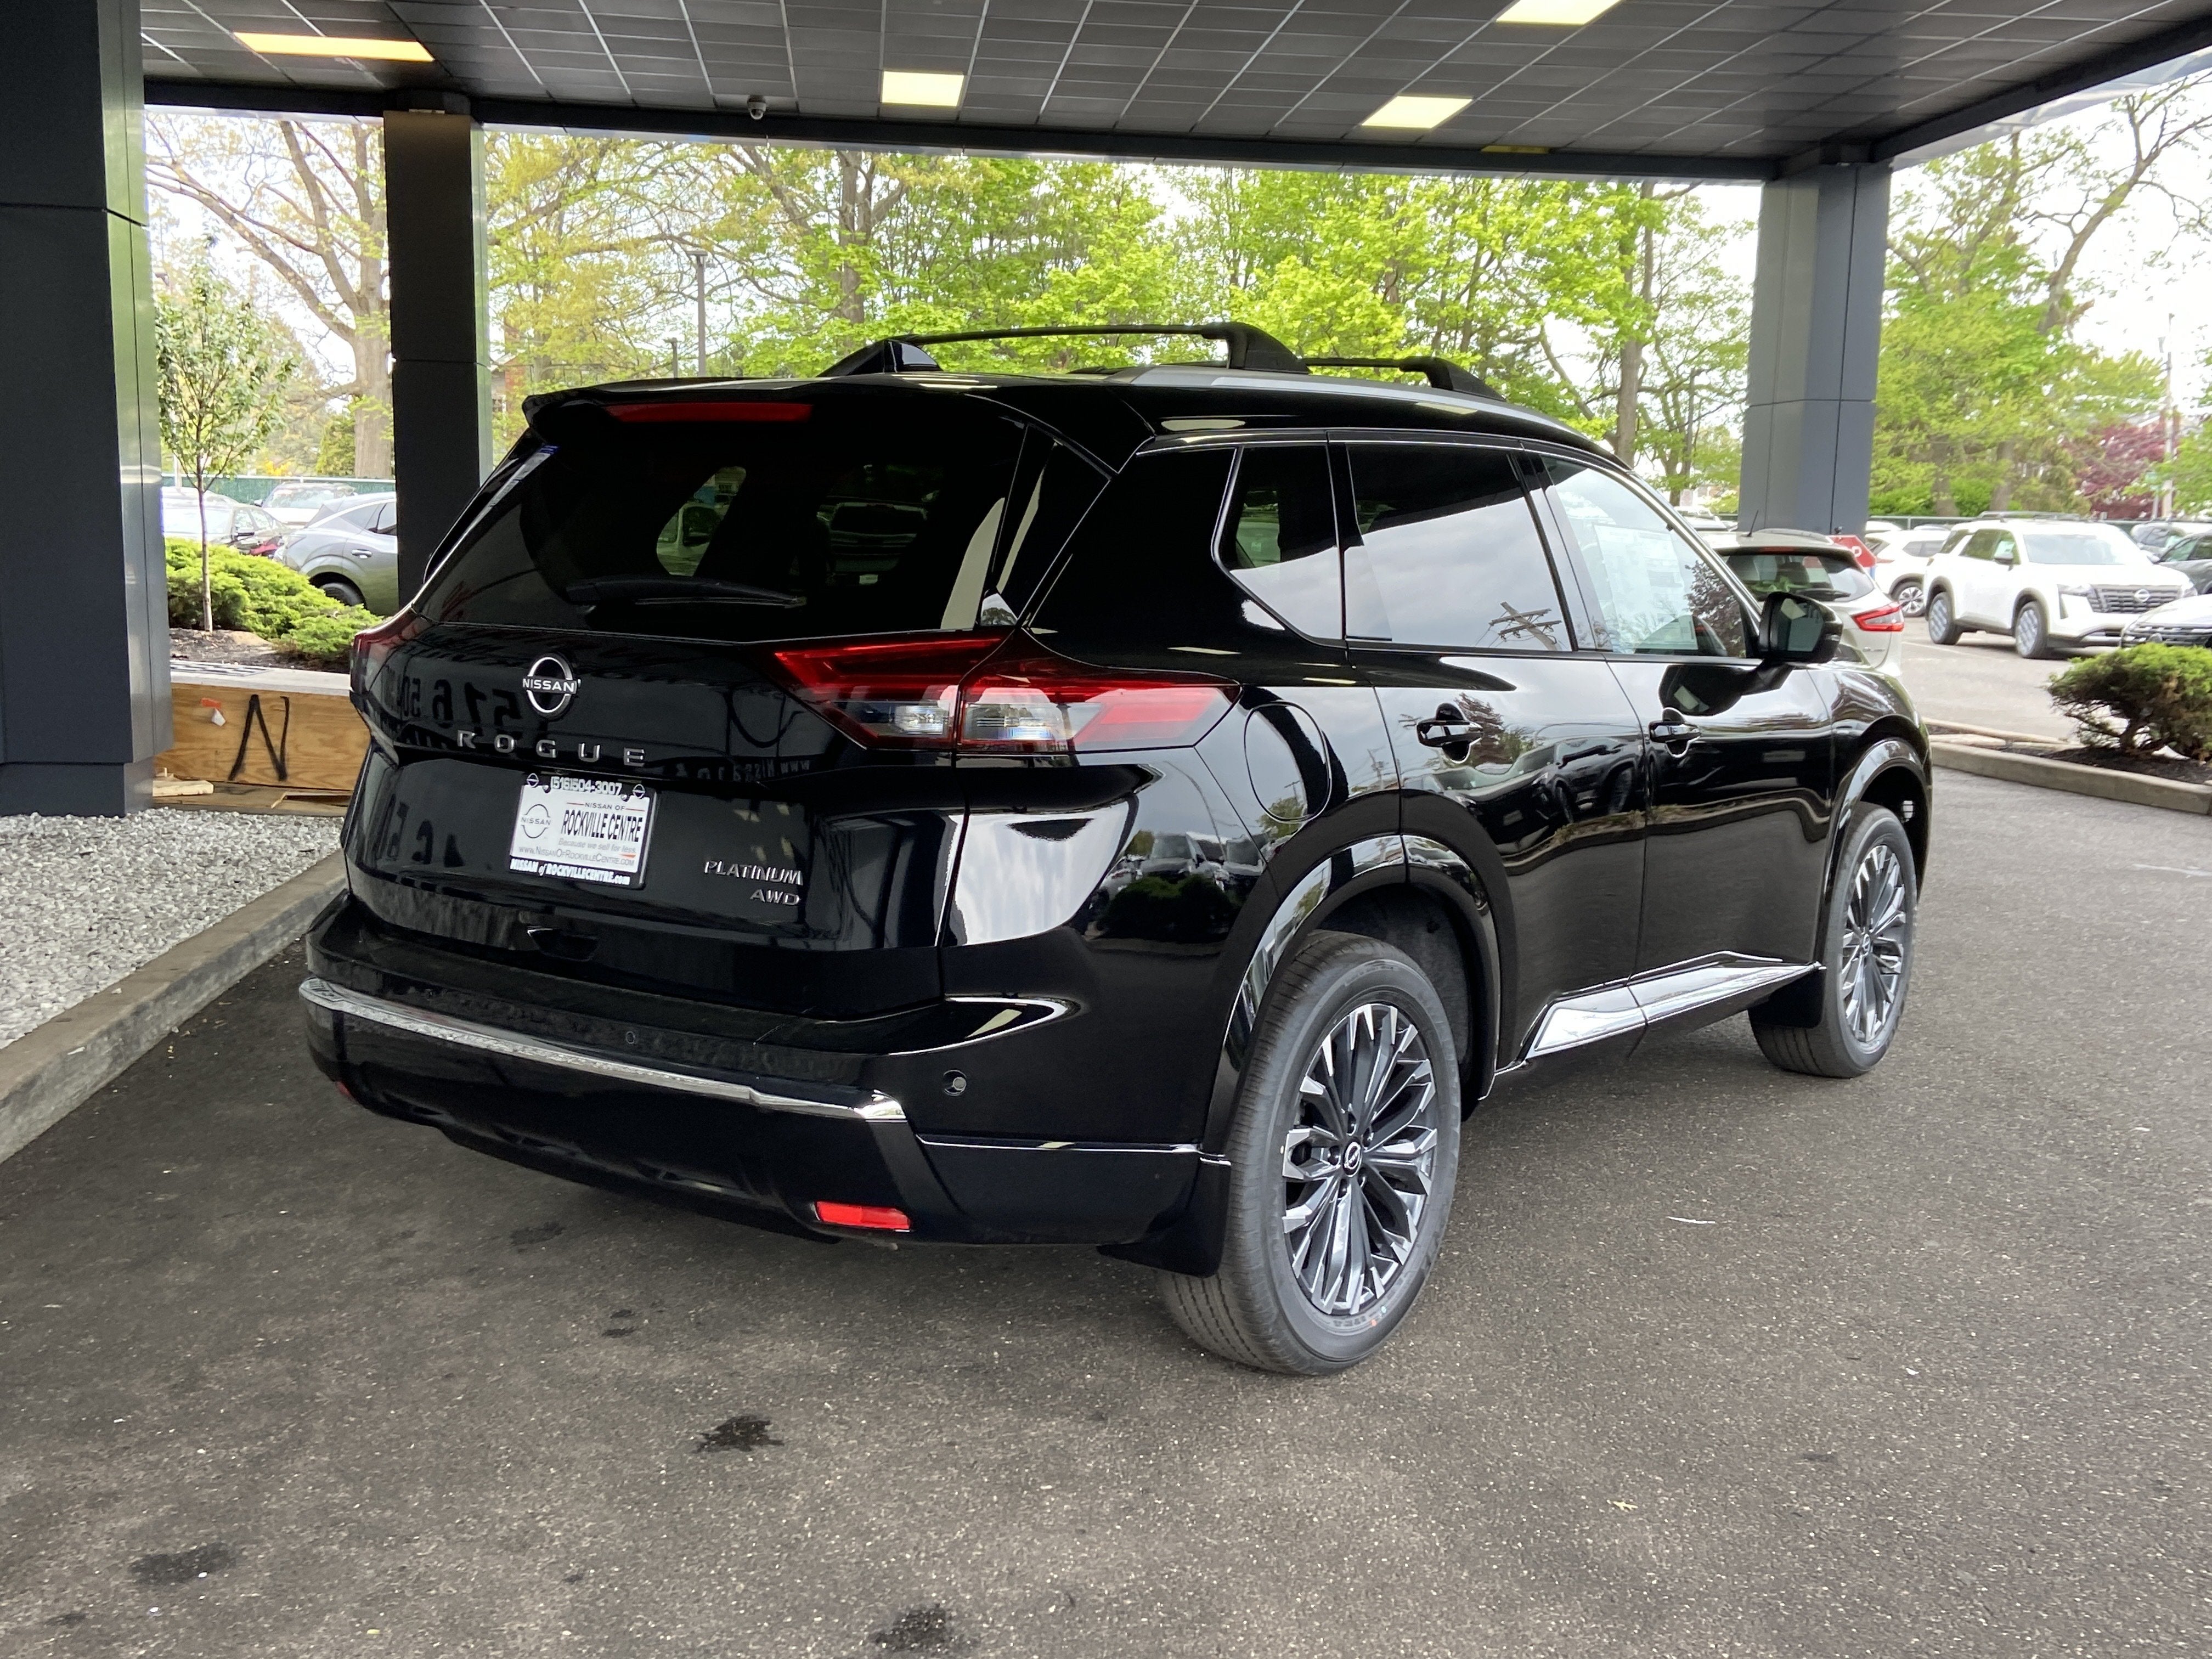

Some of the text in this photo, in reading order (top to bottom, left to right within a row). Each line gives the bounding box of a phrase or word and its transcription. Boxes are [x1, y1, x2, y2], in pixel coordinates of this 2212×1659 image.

[522, 678, 574, 692] NISSAN
[228, 693, 290, 782] N
[457, 730, 646, 767] ROGUE
[521, 816, 551, 825] NISSAN
[561, 809, 643, 843] ROCKVILLE CENTRE
[558, 838, 586, 848] Because
[599, 843, 610, 851] sell
[510, 858, 539, 873] NISSAN
[538, 864, 547, 876] of
[704, 860, 803, 886] PLATINUM
[749, 889, 800, 905] AWD
